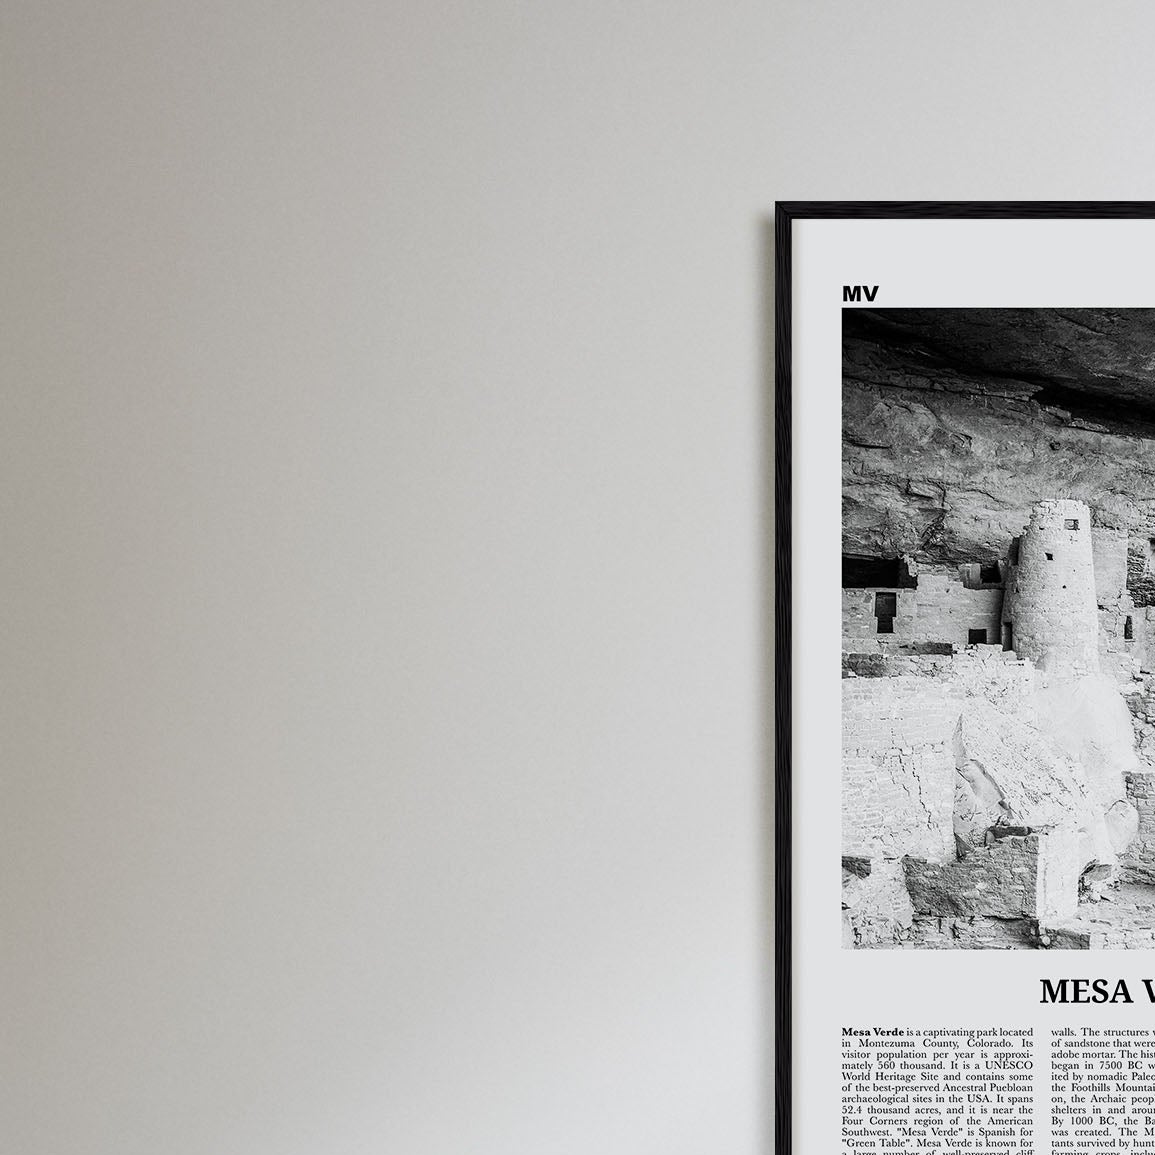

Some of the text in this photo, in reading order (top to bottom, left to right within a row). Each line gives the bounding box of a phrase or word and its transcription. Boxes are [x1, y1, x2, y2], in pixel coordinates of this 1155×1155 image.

[843, 286, 879, 302] MV
[1040, 979, 1134, 1004] MESA
[842, 1028, 1034, 1039] Mesa Verde is a captivating park located
[1051, 1028, 1077, 1037] walls.
[1080, 1028, 1100, 1037] The
[1103, 1028, 1150, 1037] structures
[841, 1050, 1033, 1061] visitor population per year is approxi-
[1051, 1050, 1080, 1059] adobe
[1082, 1050, 1116, 1059] mortar.
[1118, 1050, 1138, 1059] The
[841, 1072, 871, 1081] World
[875, 1072, 916, 1083] Heritage
[920, 1072, 939, 1081] Site
[943, 1072, 961, 1081] and
[965, 1072, 1005, 1081] contains
[1051, 1072, 1069, 1081] ited
[1072, 1072, 1084, 1083] by
[1087, 1072, 1128, 1081] nomadic
[841, 1094, 1034, 1106] archaeological sites in the USA. It spans
[1051, 1096, 1067, 1104] on,
[1071, 1094, 1086, 1103] the
[1090, 1094, 1127, 1103] Archaic
[842, 1116, 1033, 1128] Four Corners region of the American
[1051, 1116, 1064, 1128] By
[1071, 1116, 1094, 1125] 1000
[1099, 1116, 1118, 1126] BC,
[1123, 1116, 1139, 1125] the
[842, 1139, 1034, 1148] "Green Table". Mesa Verde is known for
[1051, 1139, 1074, 1148] tants
[1077, 1139, 1116, 1148] survived
[1118, 1139, 1130, 1150] by
